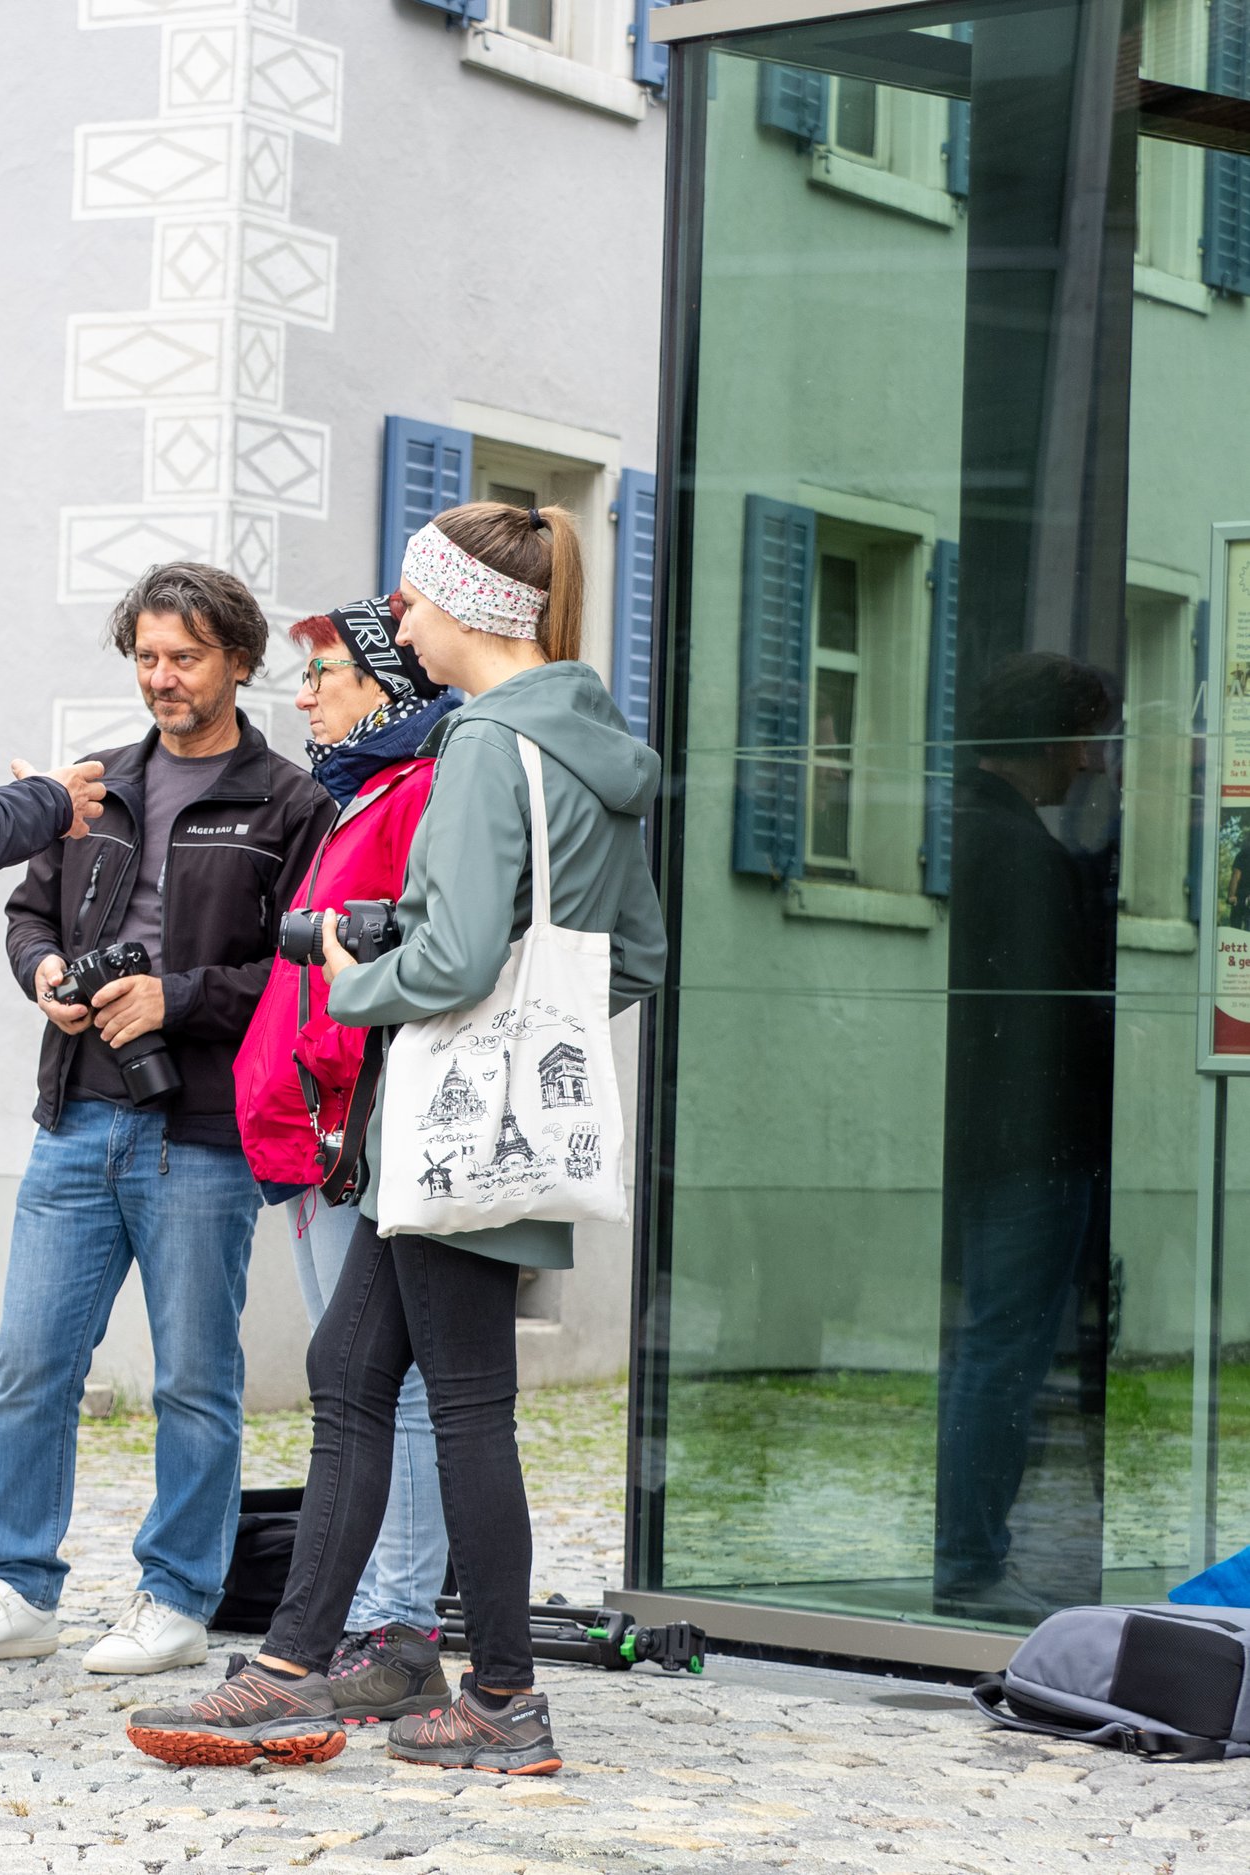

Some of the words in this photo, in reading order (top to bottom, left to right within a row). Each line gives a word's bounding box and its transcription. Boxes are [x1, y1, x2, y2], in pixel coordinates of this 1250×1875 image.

[186, 825, 215, 835] JÄGER
[215, 826, 233, 834] BAU
[1218, 941, 1248, 953] Jetzt
[1228, 955, 1236, 967] &
